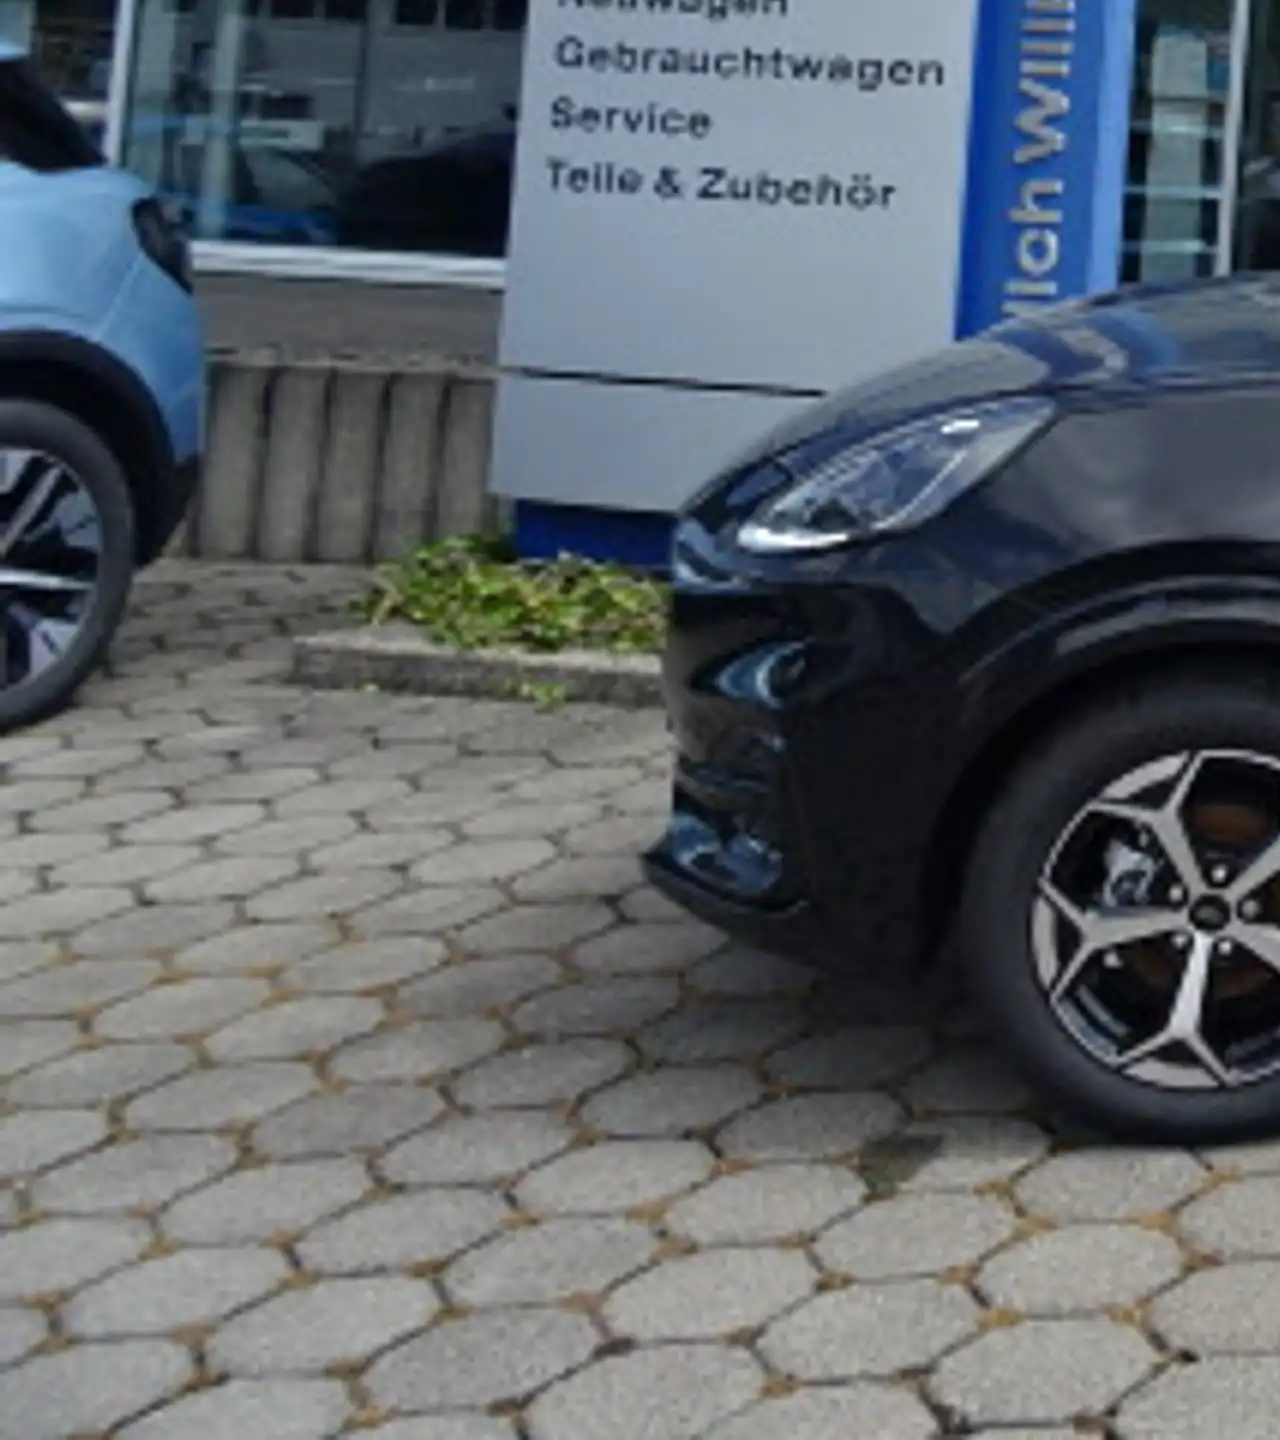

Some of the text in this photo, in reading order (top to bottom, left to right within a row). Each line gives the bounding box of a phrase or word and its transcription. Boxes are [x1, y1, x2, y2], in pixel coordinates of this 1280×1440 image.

[554, 35, 945, 92] Gebrauchtwagen
[549, 96, 713, 140] Service
[545, 159, 897, 210] Teile & Zubehör
